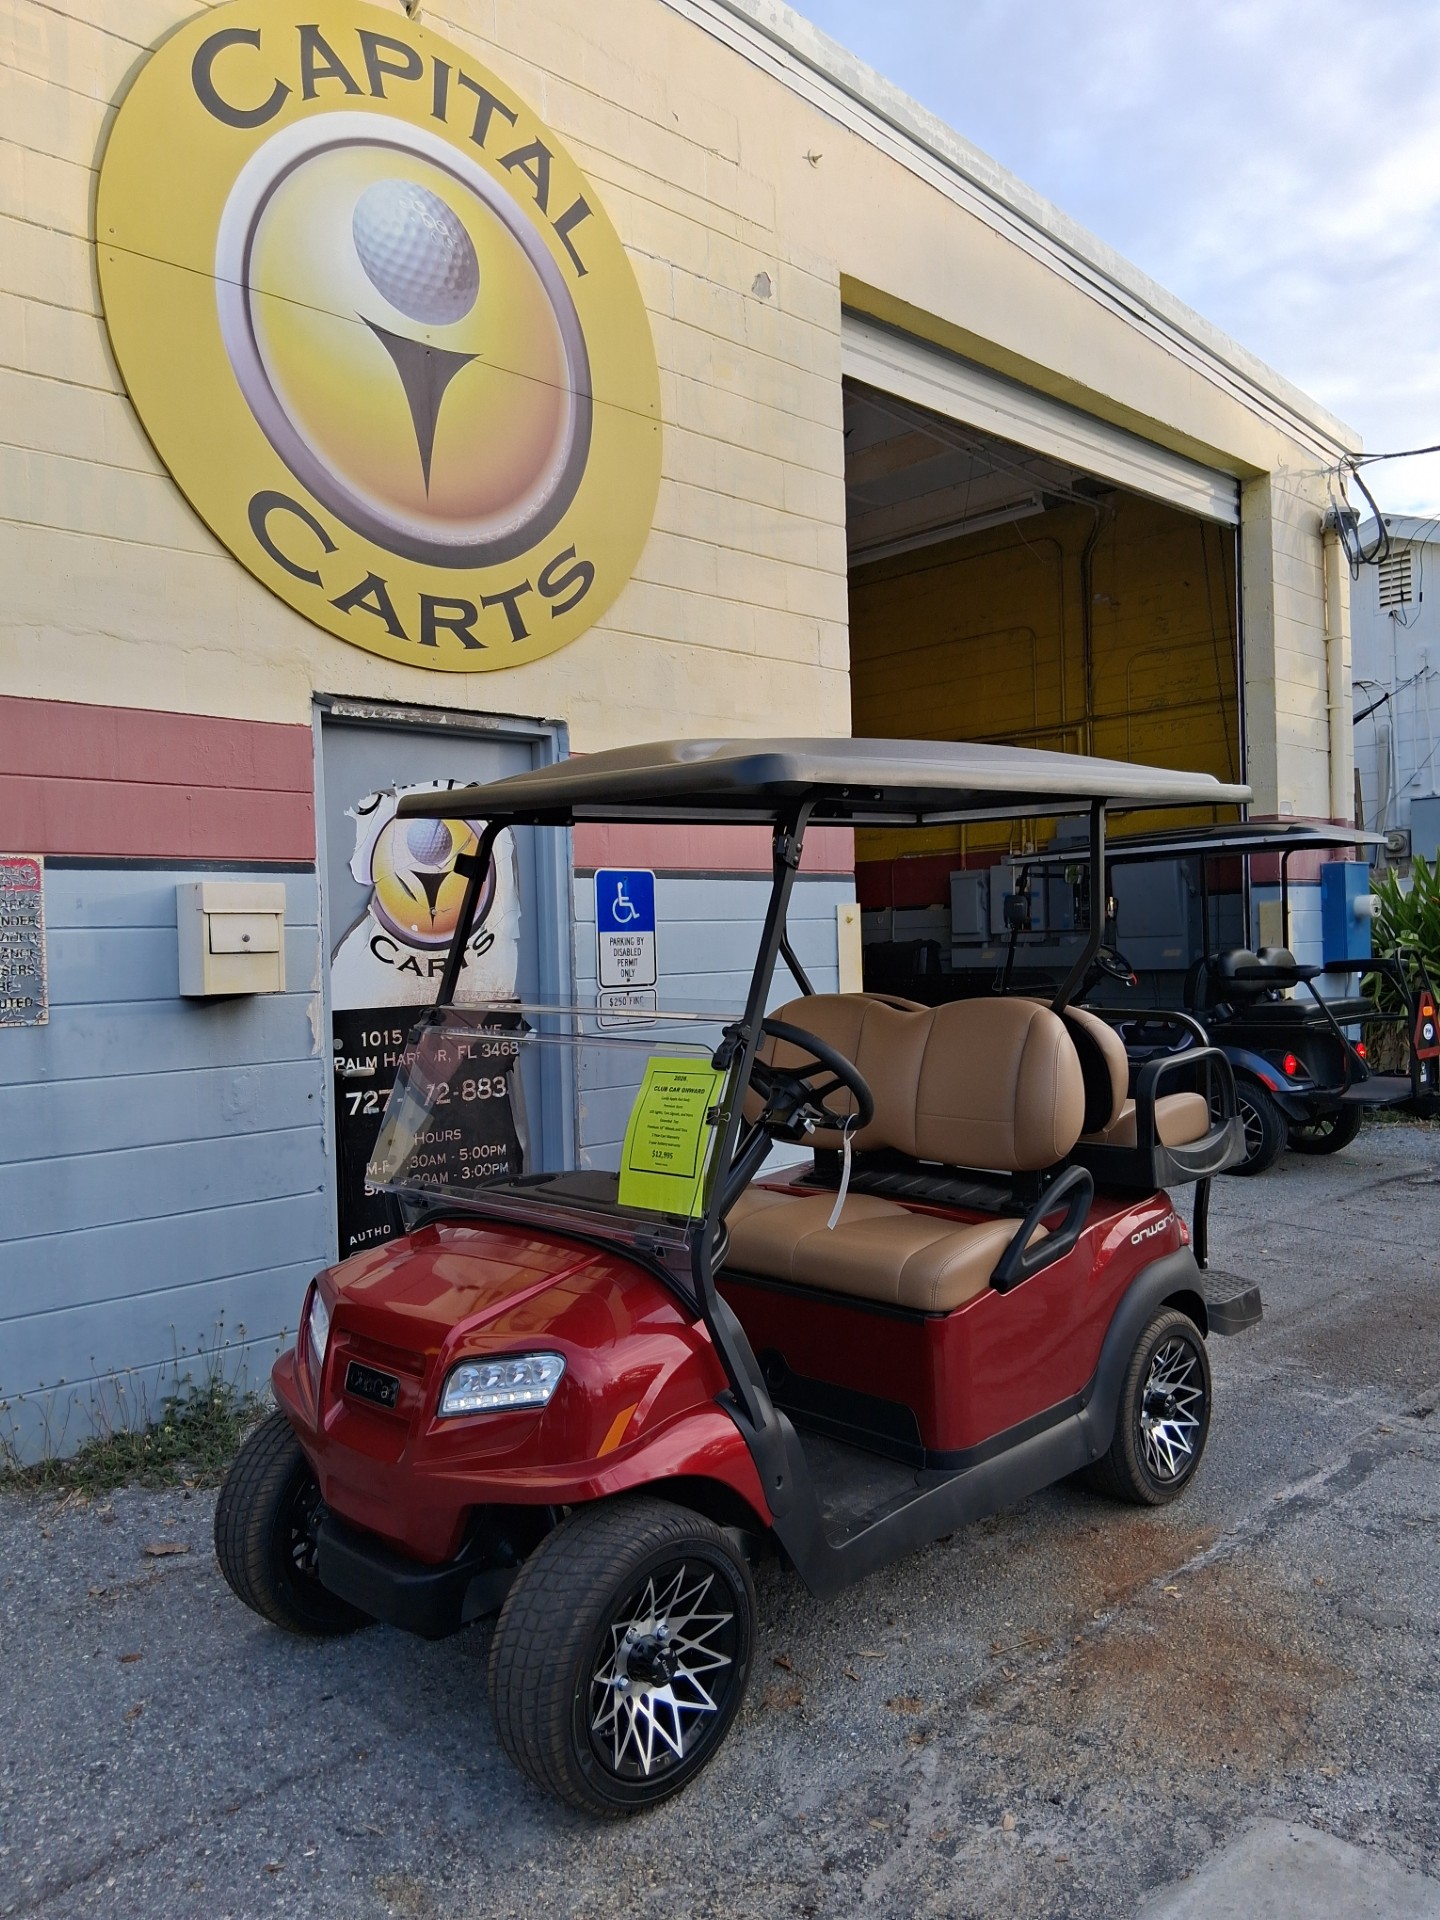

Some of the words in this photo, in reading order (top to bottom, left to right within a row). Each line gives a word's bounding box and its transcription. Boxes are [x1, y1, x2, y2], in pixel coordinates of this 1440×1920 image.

[191, 24, 595, 278] CAPITAL
[247, 490, 595, 650] CARTS
[609, 937, 635, 946] PARKING
[636, 937, 645, 945] BY
[613, 948, 642, 957] DISABLED
[617, 958, 638, 967] PERMIT
[620, 968, 636, 978] ONLY
[609, 997, 627, 1007] $250
[361, 1030, 403, 1047] 1015
[334, 1055, 378, 1071] PALM
[457, 1045, 478, 1060] FL
[481, 1041, 520, 1058] 3468
[653, 1085, 669, 1093] CLUB
[681, 1087, 706, 1095] ONWARD
[413, 1128, 463, 1146] HOURS
[459, 1143, 507, 1161] 5:00PM
[461, 1161, 510, 1180] 3:00PM
